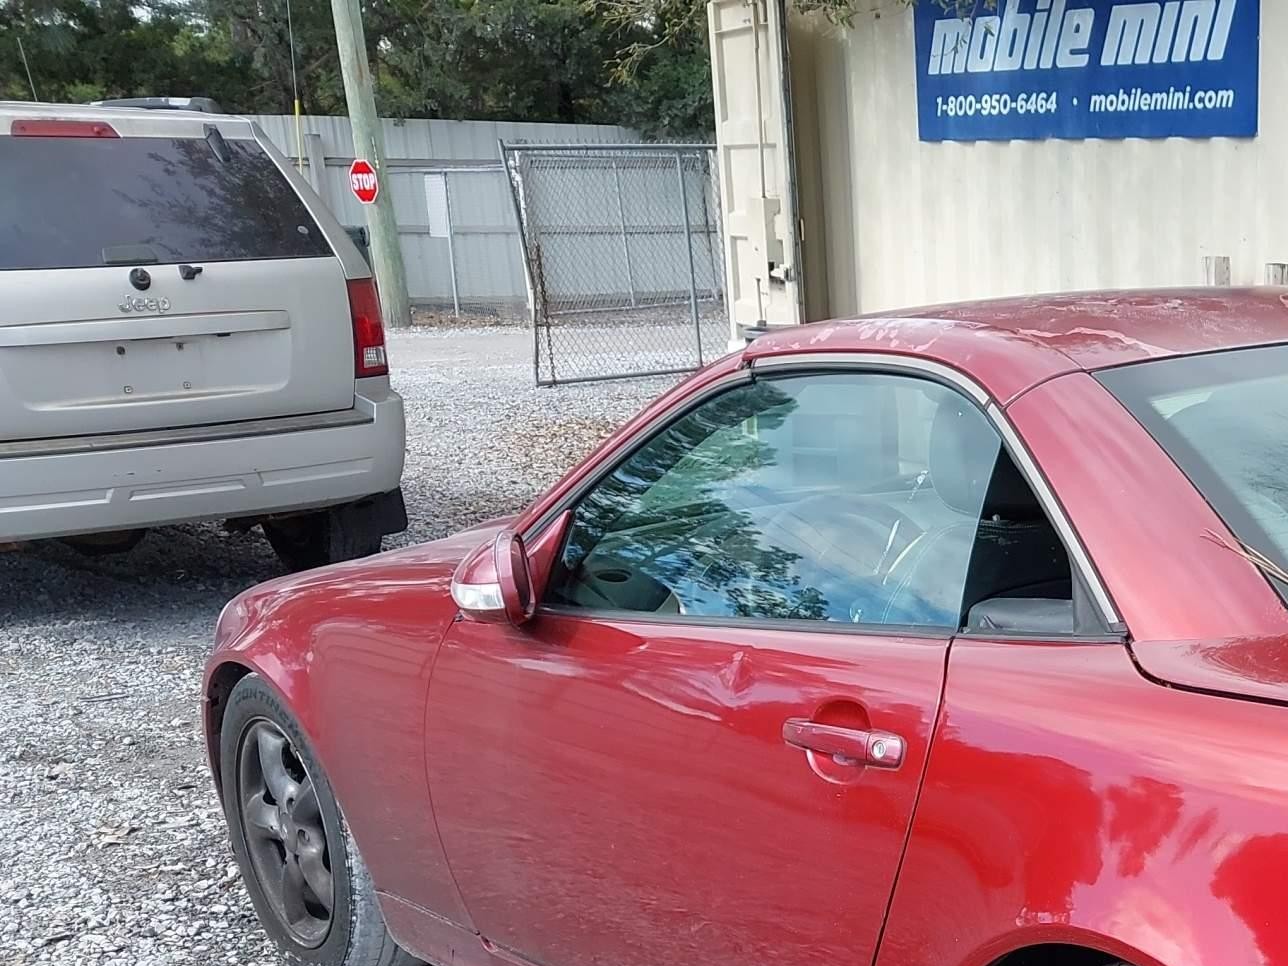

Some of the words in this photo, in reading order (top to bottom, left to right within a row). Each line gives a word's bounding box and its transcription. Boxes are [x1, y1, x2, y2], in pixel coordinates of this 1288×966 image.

[927, 0, 1095, 75] mobile
[1099, 0, 1237, 67] mini
[936, 91, 1057, 117] 1-800-950-6464
[1089, 86, 1235, 114] mobilemini.com
[351, 173, 375, 191] STOP
[119, 294, 171, 314] Jeep
